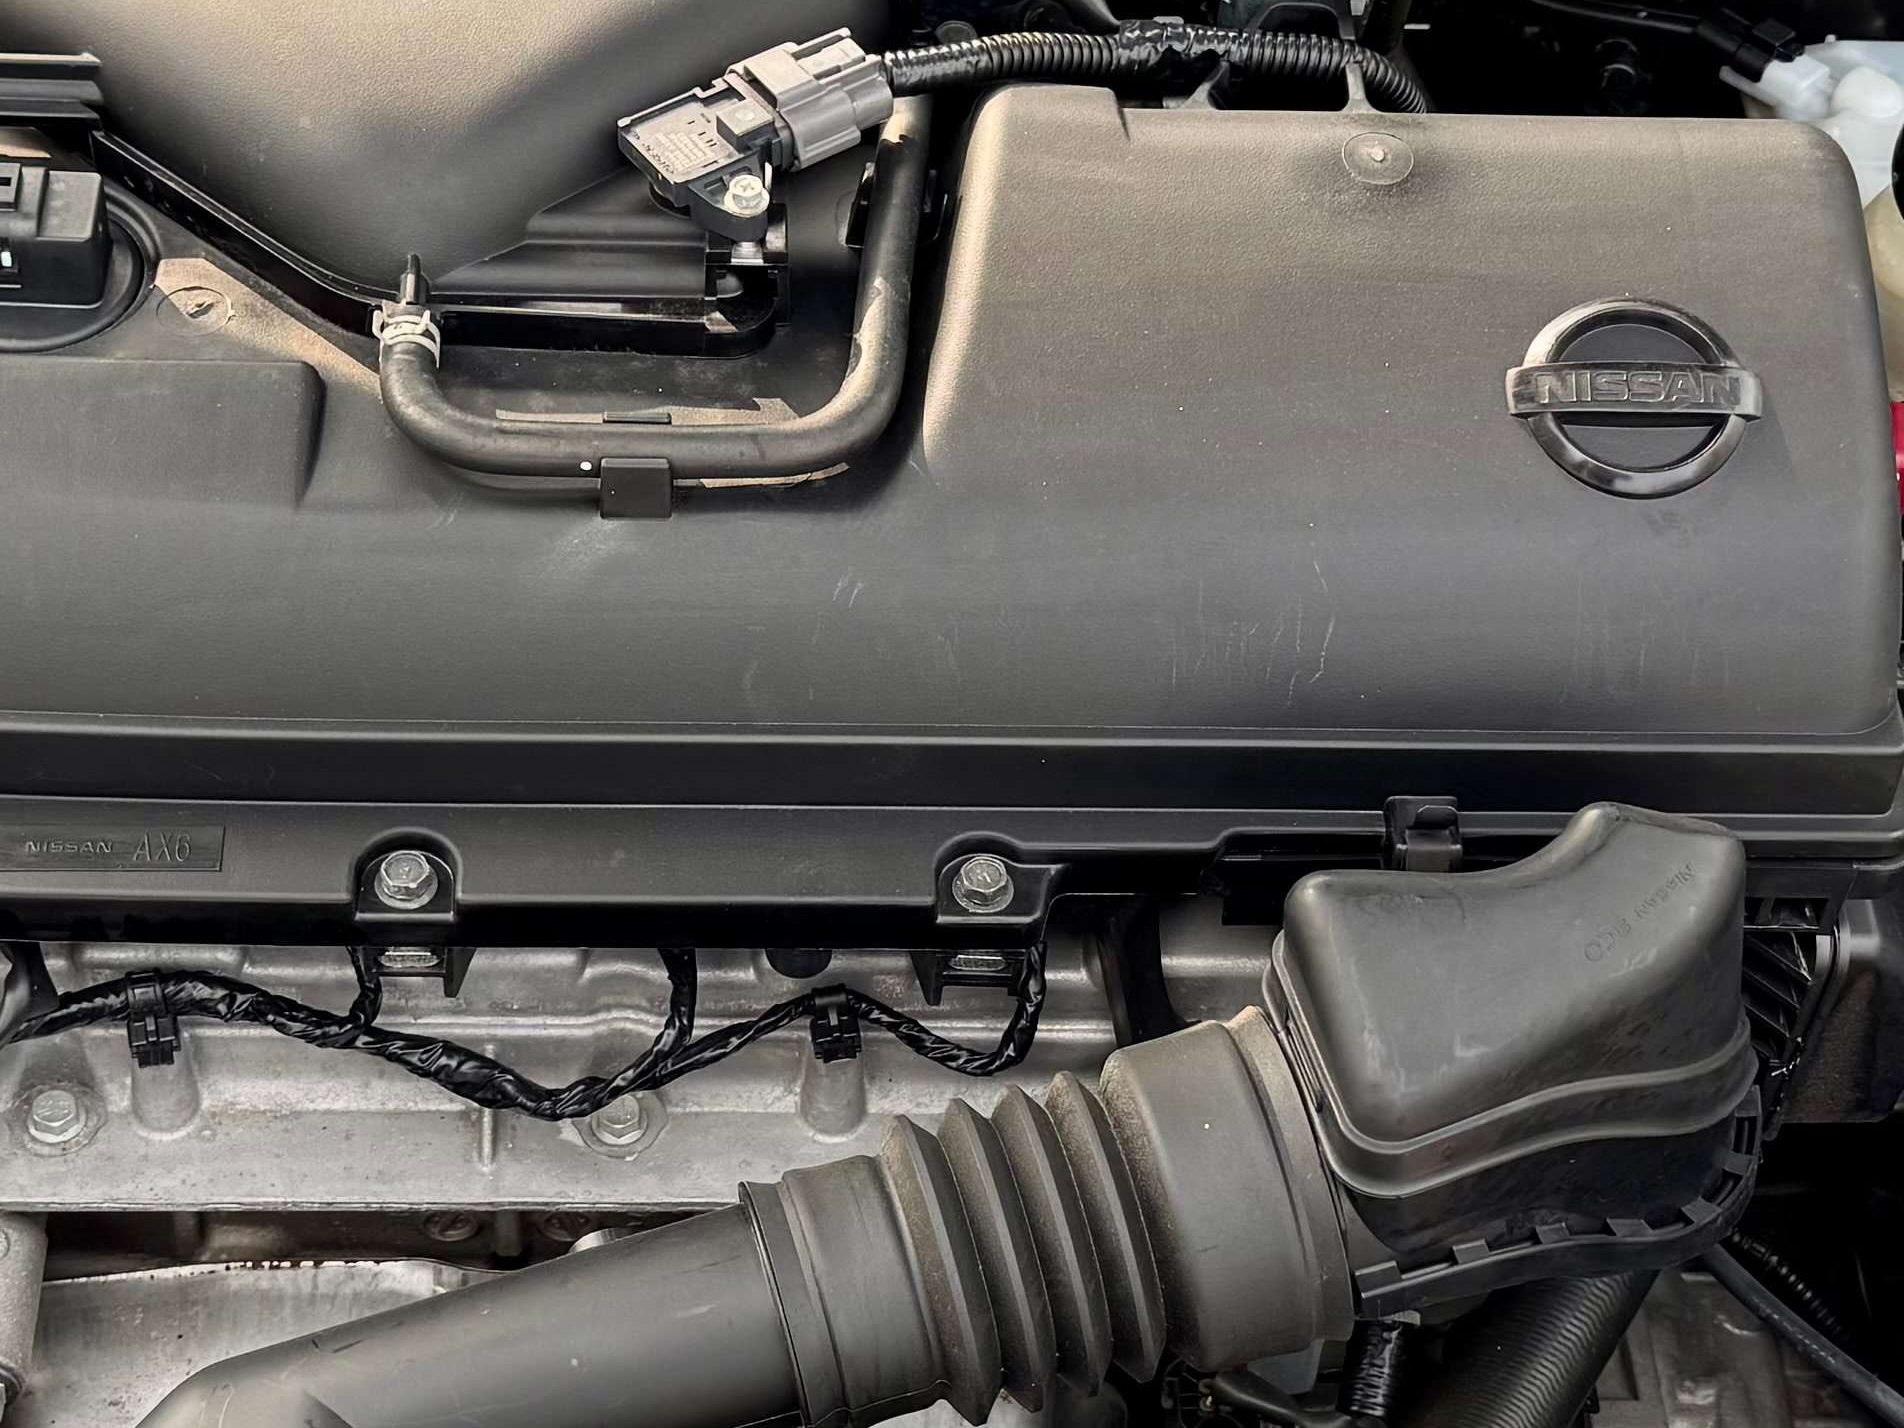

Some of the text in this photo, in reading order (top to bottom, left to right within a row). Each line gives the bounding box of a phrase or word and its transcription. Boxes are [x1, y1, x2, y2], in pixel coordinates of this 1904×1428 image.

[1535, 370, 1743, 407] NISSAN
[25, 829, 193, 862] NISSAN AX6
